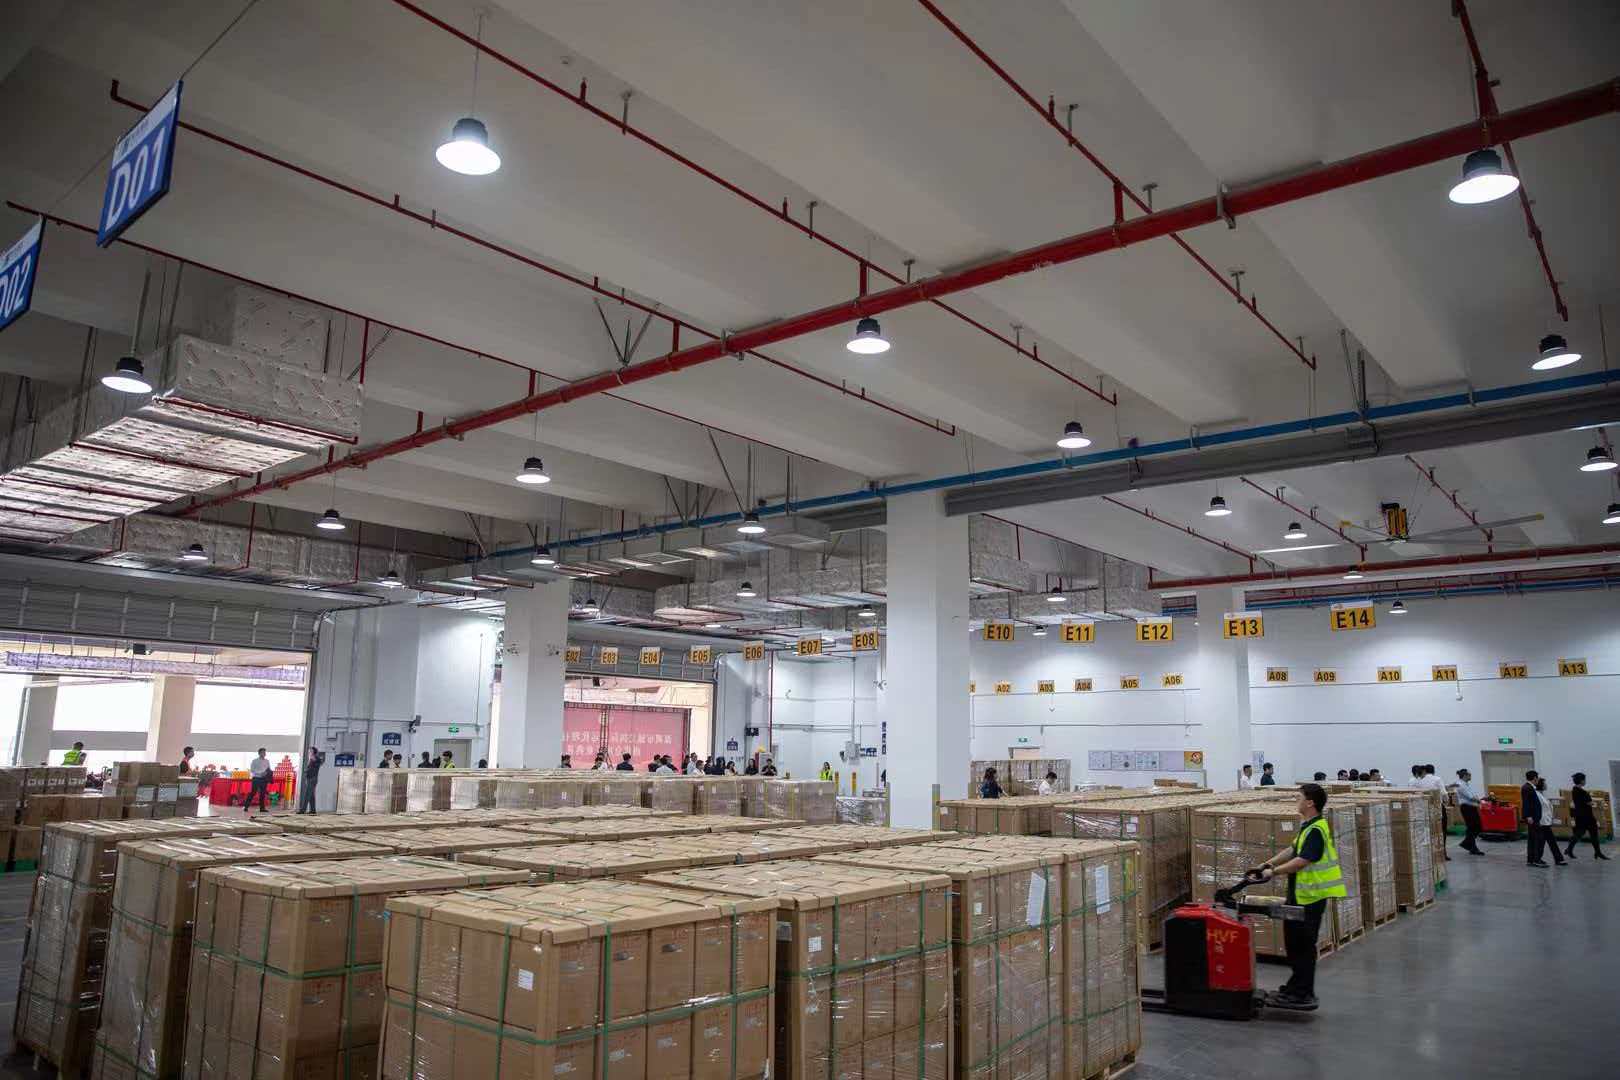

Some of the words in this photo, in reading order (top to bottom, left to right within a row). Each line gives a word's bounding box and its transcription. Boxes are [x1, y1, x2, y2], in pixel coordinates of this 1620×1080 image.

[105, 127, 165, 232] D01
[1336, 611, 1370, 629] E14
[987, 624, 1010, 640] E10
[1066, 624, 1090, 641] E11
[1141, 624, 1169, 640] E12
[1229, 619, 1258, 636] E13
[855, 633, 875, 647] E08
[745, 646, 762, 659] E06
[800, 641, 819, 654] E07
[643, 652, 658, 663] E04
[692, 650, 708, 661] E05
[1436, 670, 1456, 680] A11
[1503, 667, 1526, 678] A12
[1562, 664, 1585, 675] A13
[1164, 675, 1182, 685] A06
[1269, 672, 1287, 681] A08
[1316, 672, 1335, 682] A09
[1381, 671, 1400, 681] A10
[1122, 679, 1139, 689] A05
